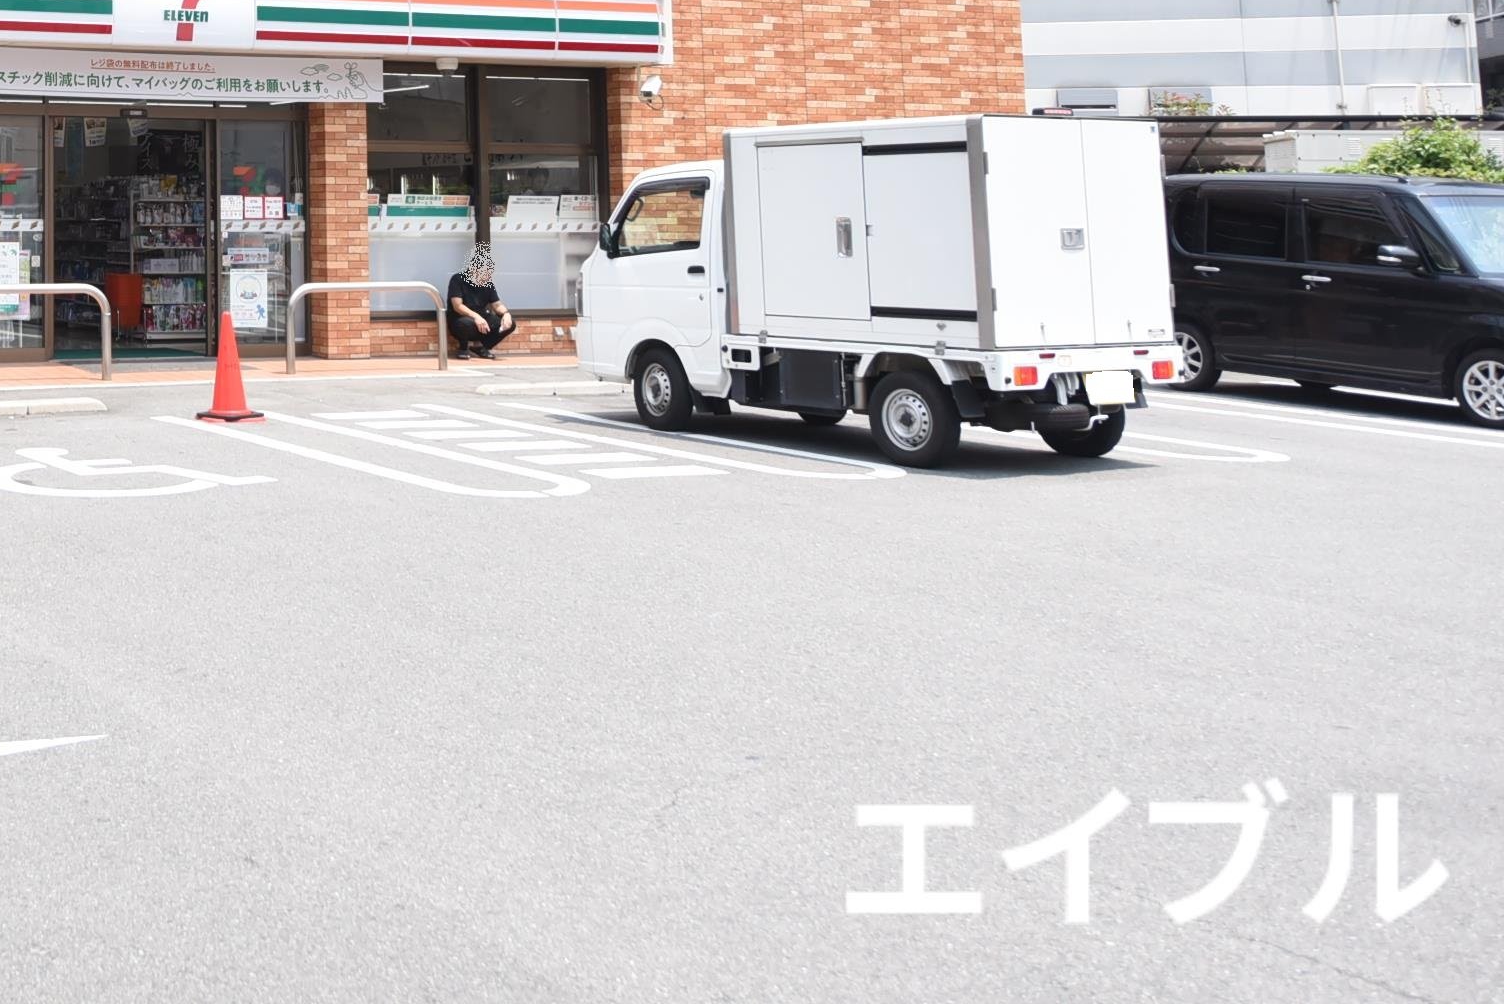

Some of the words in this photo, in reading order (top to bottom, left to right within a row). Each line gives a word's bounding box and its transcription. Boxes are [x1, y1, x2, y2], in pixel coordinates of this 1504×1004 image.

[90, 58, 216, 72] レジ袋の無料配布は終了しました。
